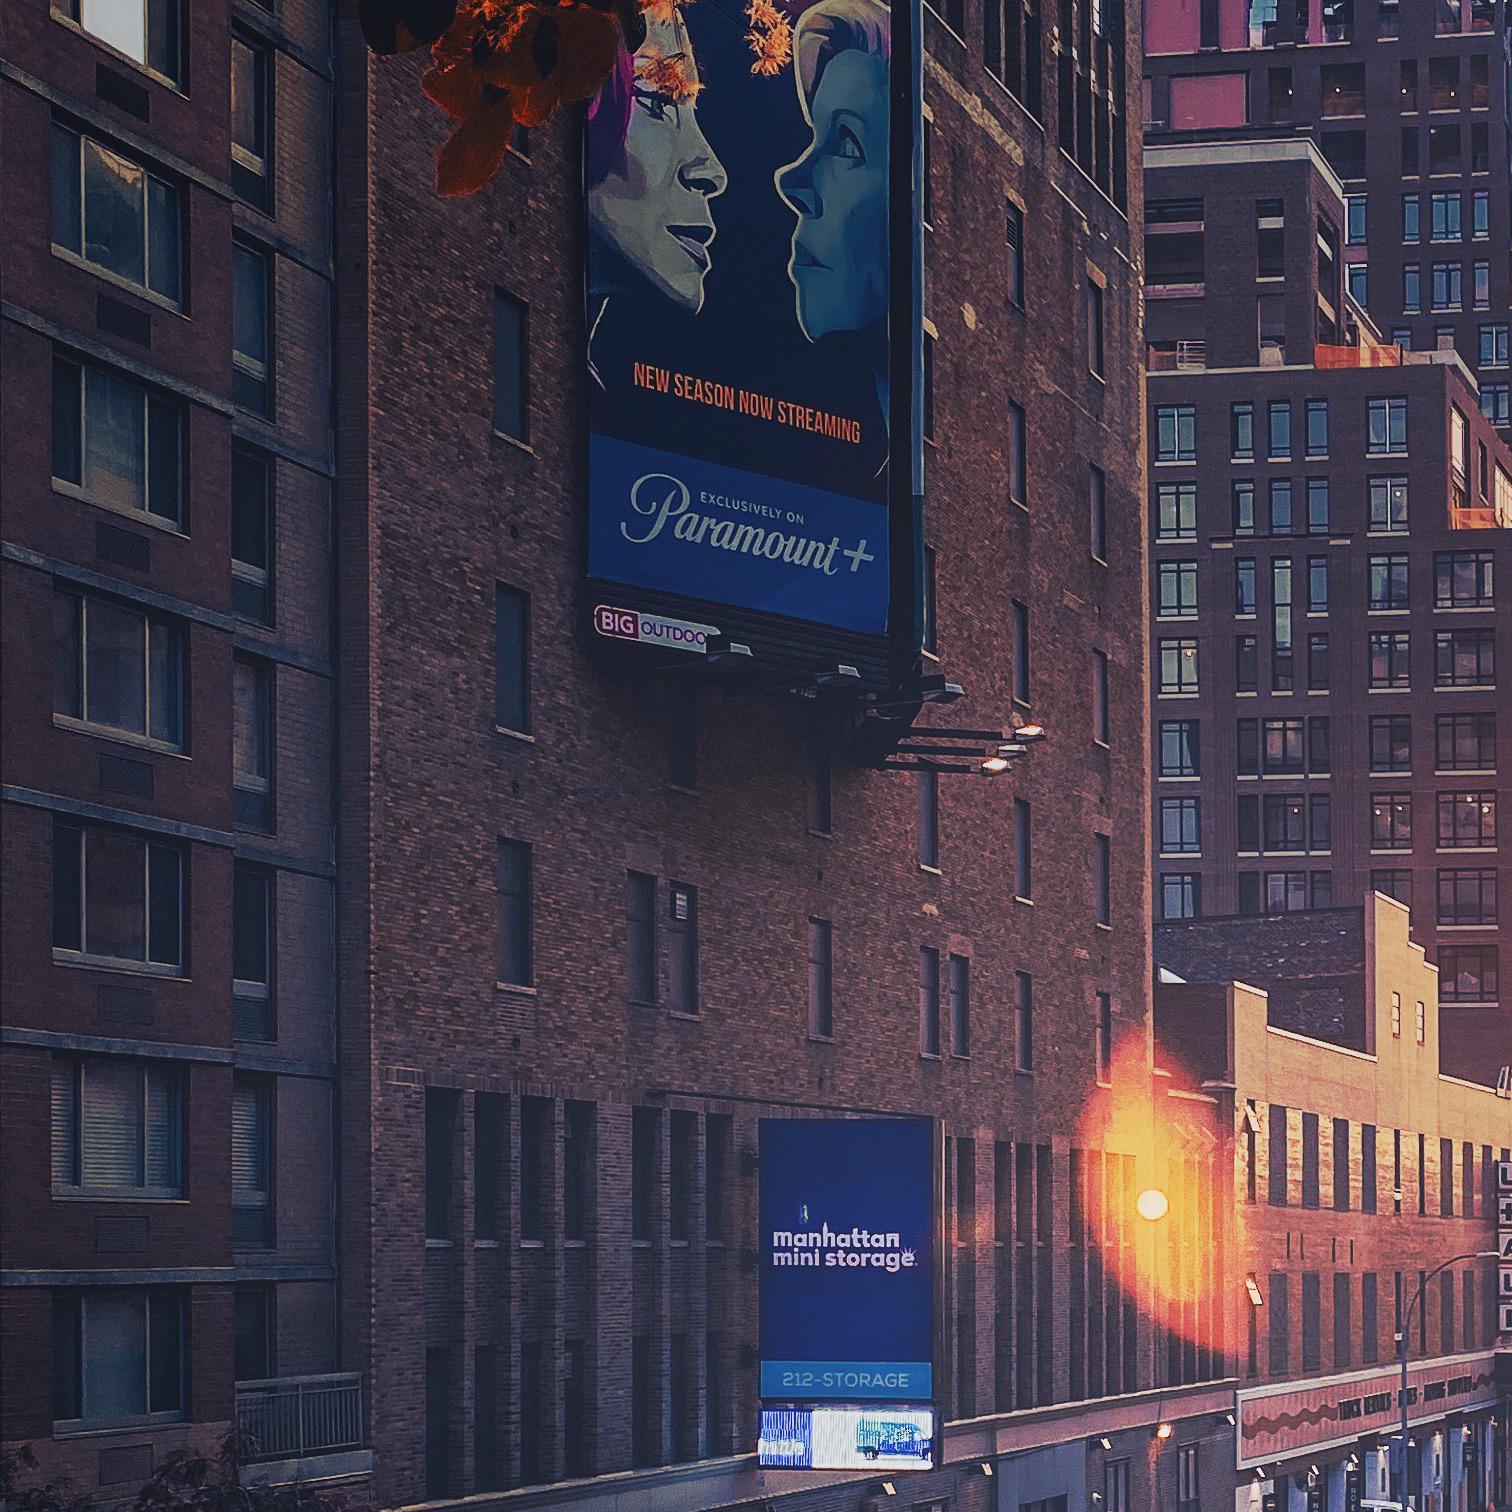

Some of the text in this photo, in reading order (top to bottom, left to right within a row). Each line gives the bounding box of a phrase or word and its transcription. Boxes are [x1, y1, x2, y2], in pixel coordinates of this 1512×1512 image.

[633, 362, 861, 443] NEW SEASON NOW STREAMING
[700, 491, 804, 525] EXCLUSIVELY ON
[601, 611, 707, 645] BIG OUTDOO
[773, 1221, 901, 1248] manhattan
[773, 1248, 916, 1272] mini storage
[782, 1371, 909, 1388] 212-STORAGE
[1349, 1487, 1358, 1502] NO
